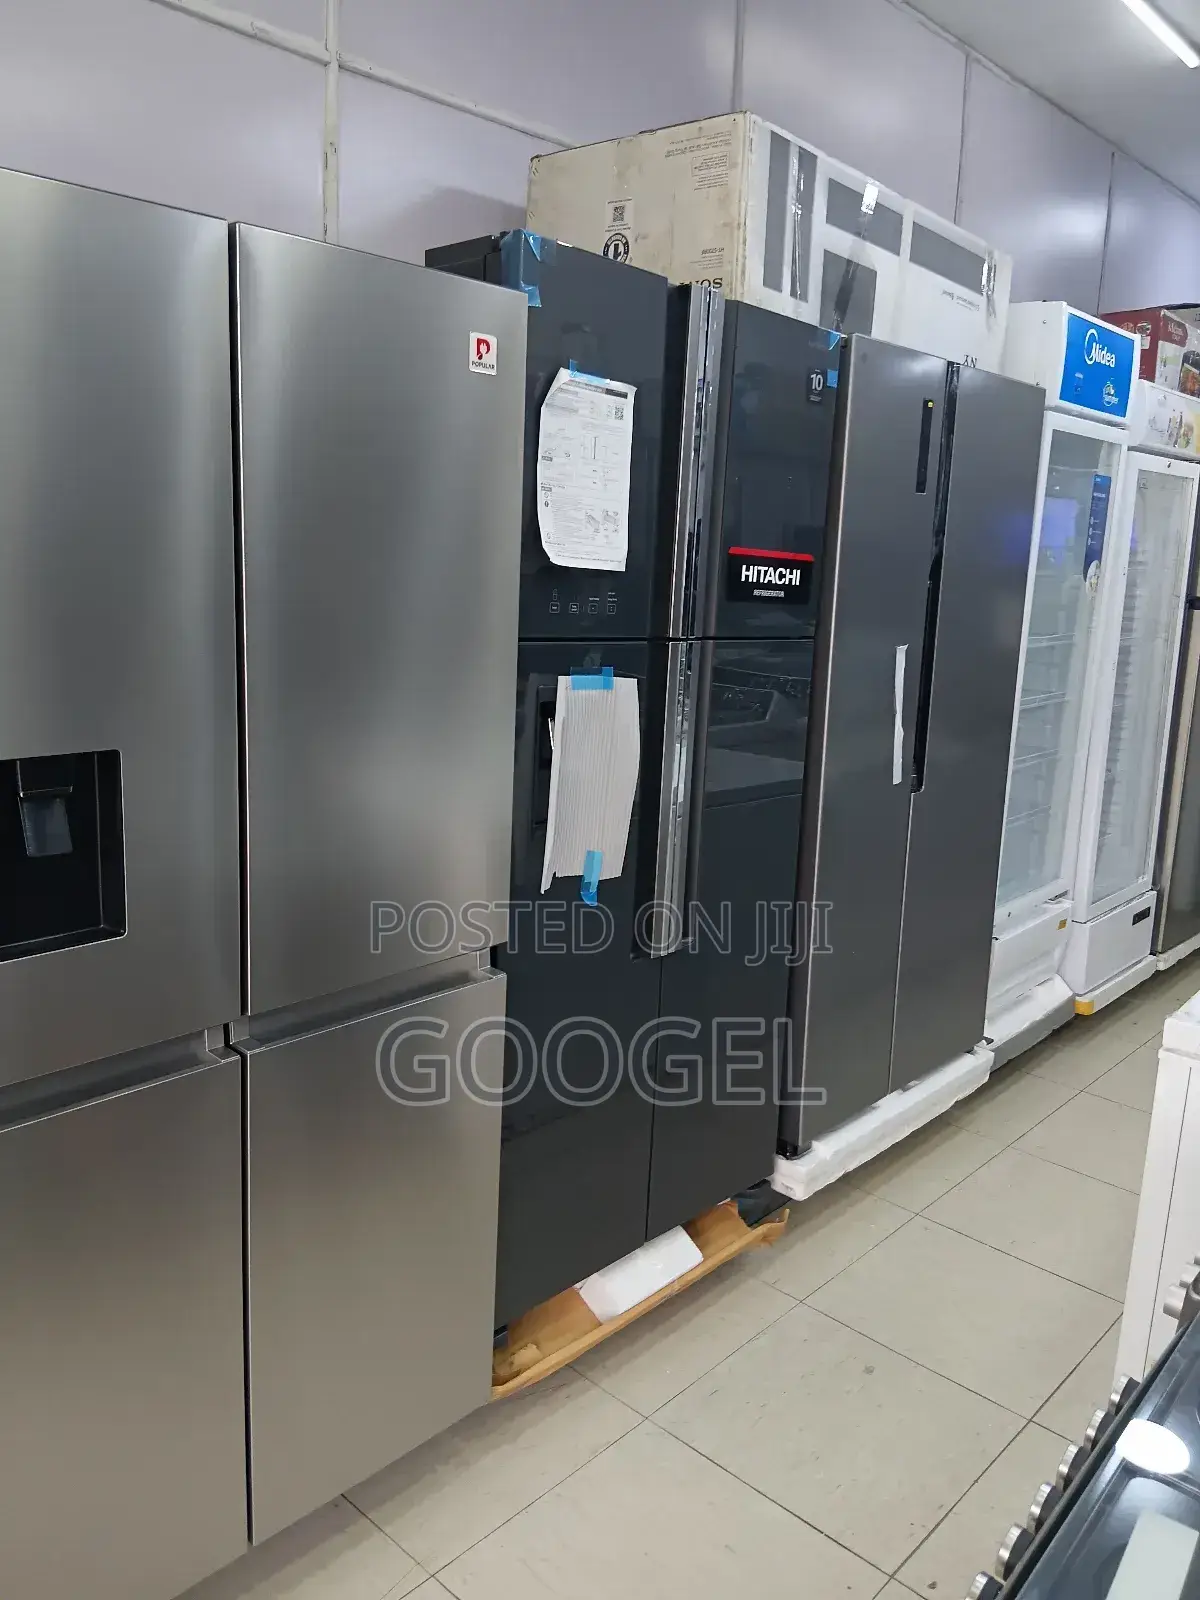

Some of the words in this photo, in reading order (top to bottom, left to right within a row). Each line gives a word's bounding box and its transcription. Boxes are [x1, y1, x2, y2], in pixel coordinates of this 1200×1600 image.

[1084, 328, 1116, 368] Midea
[471, 360, 496, 370] POPULAR
[810, 373, 824, 391] 10
[740, 564, 801, 586] HITACHI
